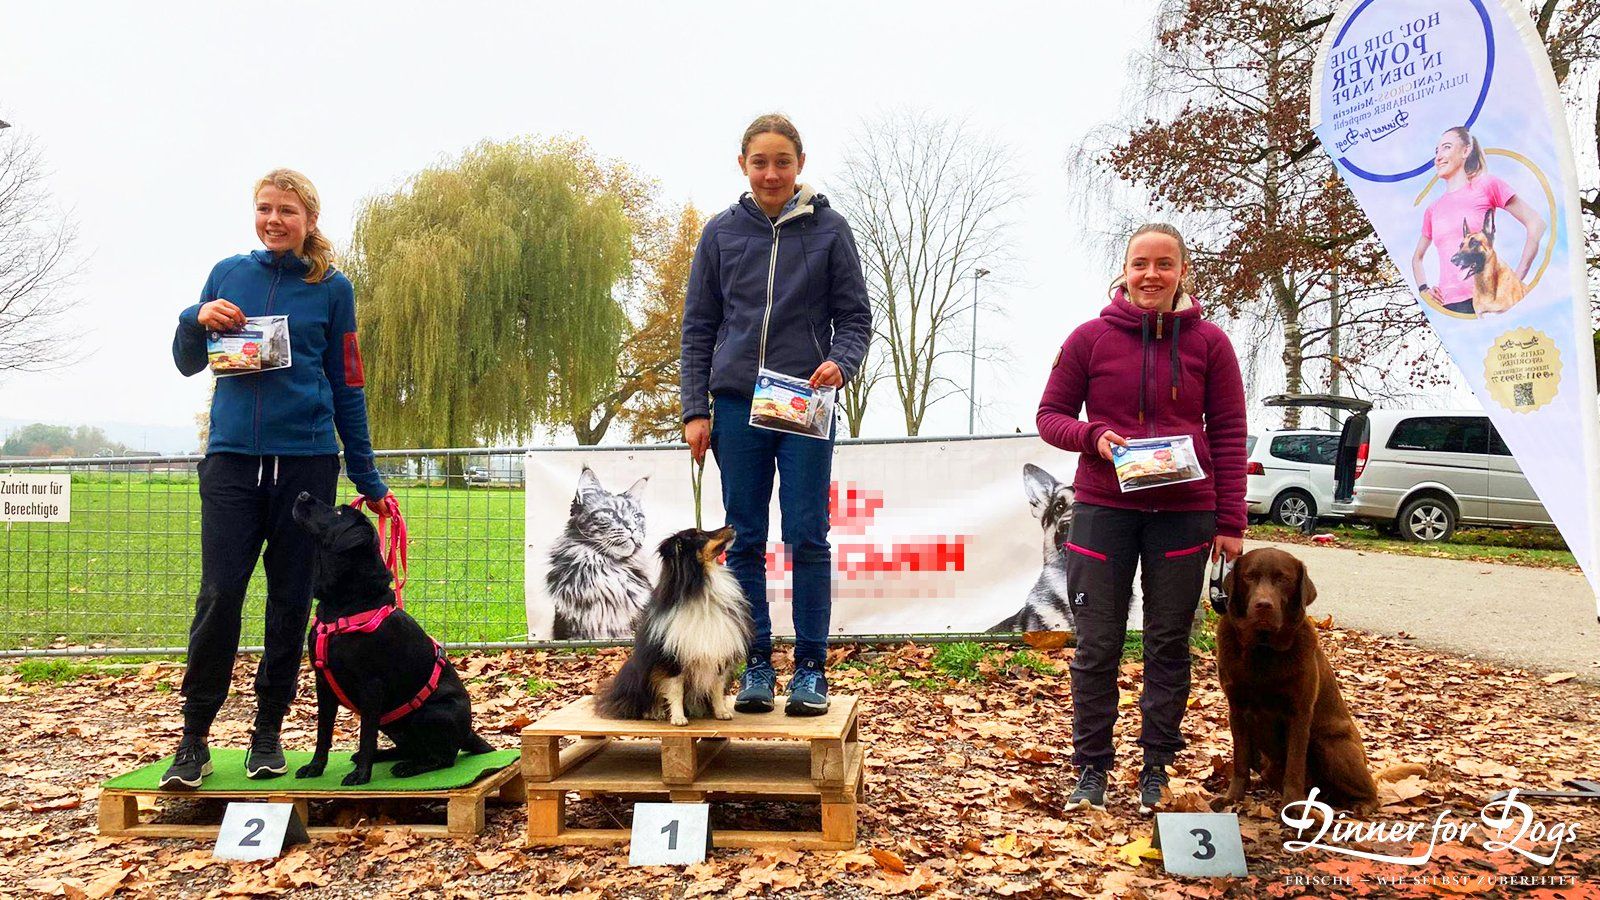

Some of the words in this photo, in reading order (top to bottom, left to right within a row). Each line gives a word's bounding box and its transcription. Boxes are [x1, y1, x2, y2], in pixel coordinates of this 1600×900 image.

[1, 480, 29, 495] Zutritt
[32, 484, 47, 495] nur
[50, 481, 63, 495] für
[4, 501, 59, 519] Berechtigte
[238, 818, 265, 847] 2
[660, 819, 679, 850] 1
[1189, 828, 1216, 860] 3
